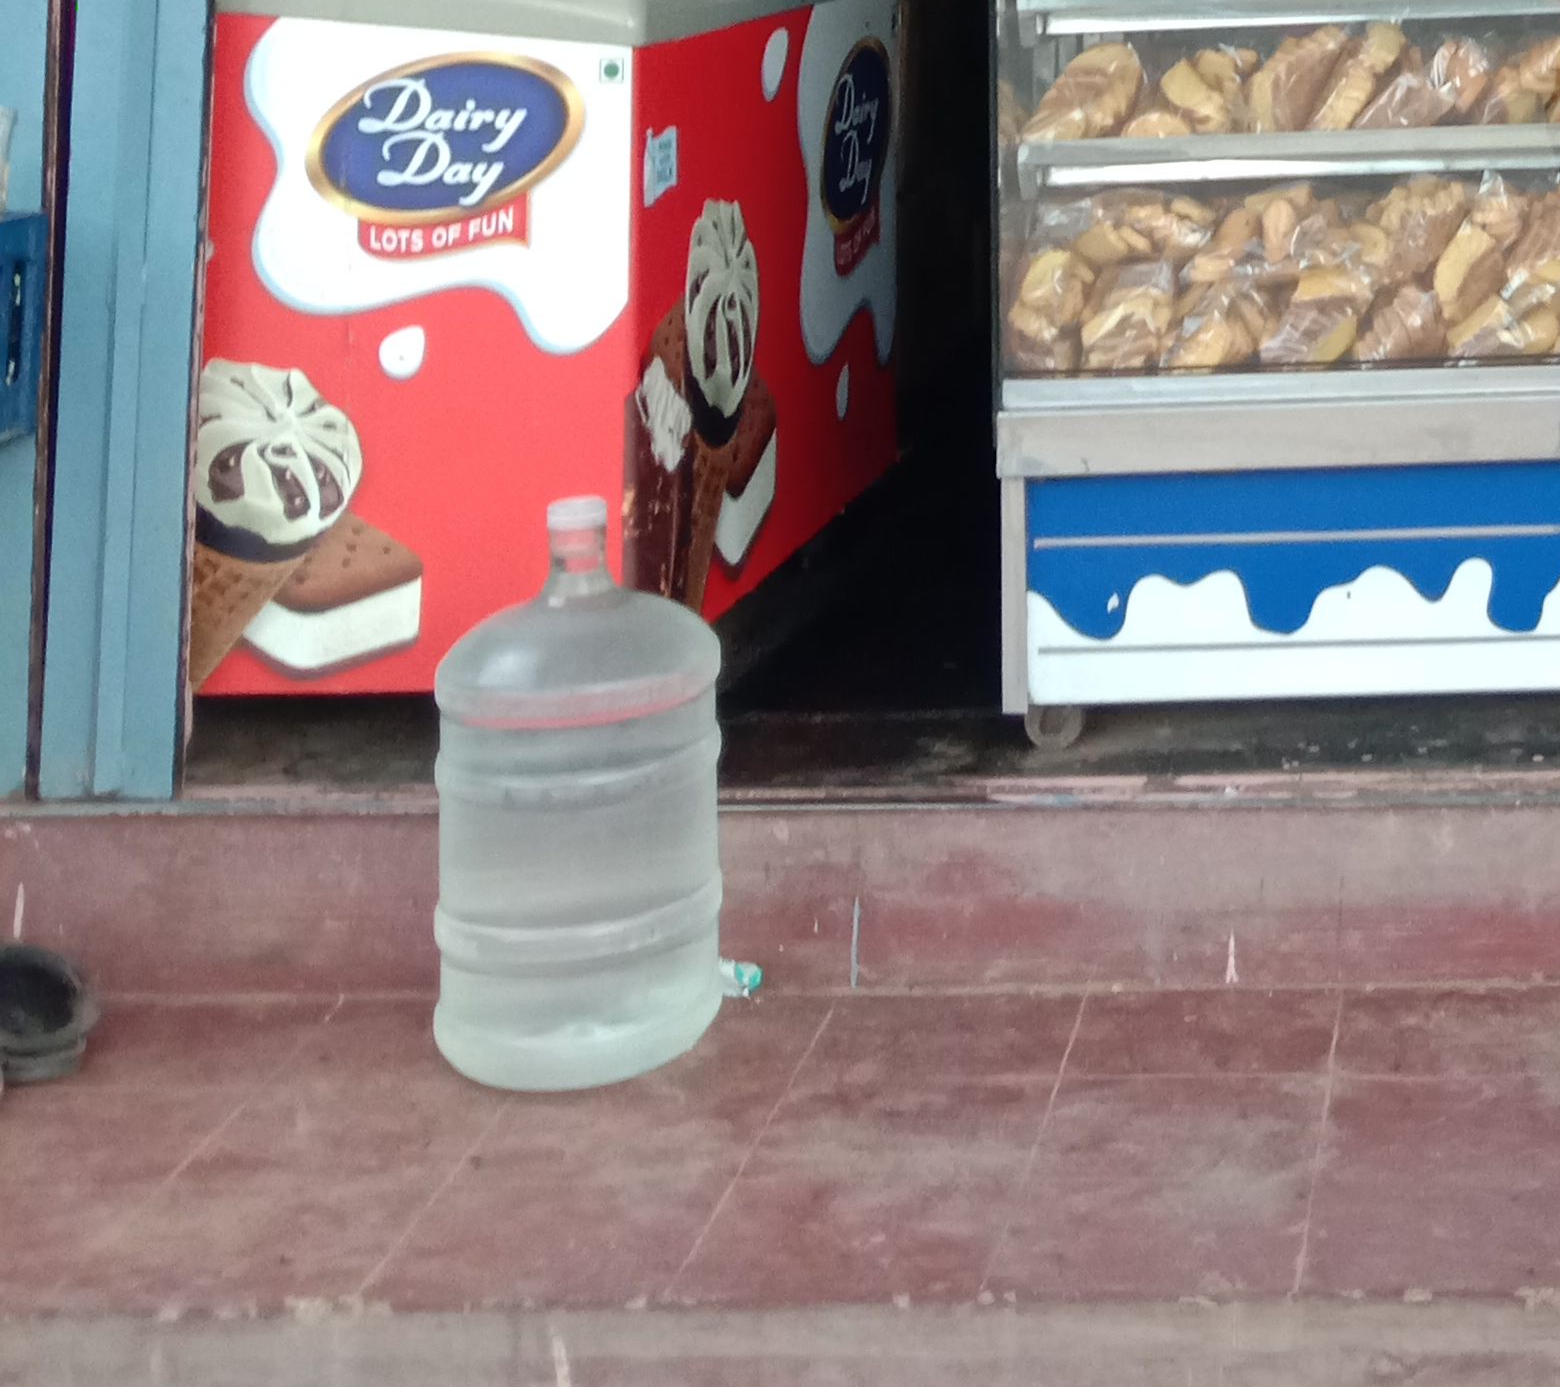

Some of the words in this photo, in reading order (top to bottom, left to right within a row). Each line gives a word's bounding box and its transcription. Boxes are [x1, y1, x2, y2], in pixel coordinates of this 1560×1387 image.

[357, 76, 528, 153] Dairy
[834, 73, 880, 145] Dairy
[376, 129, 505, 207] Day
[839, 128, 873, 206] Day
[369, 224, 424, 254] LOTS
[431, 225, 462, 246] OF
[468, 206, 515, 238] FUN
